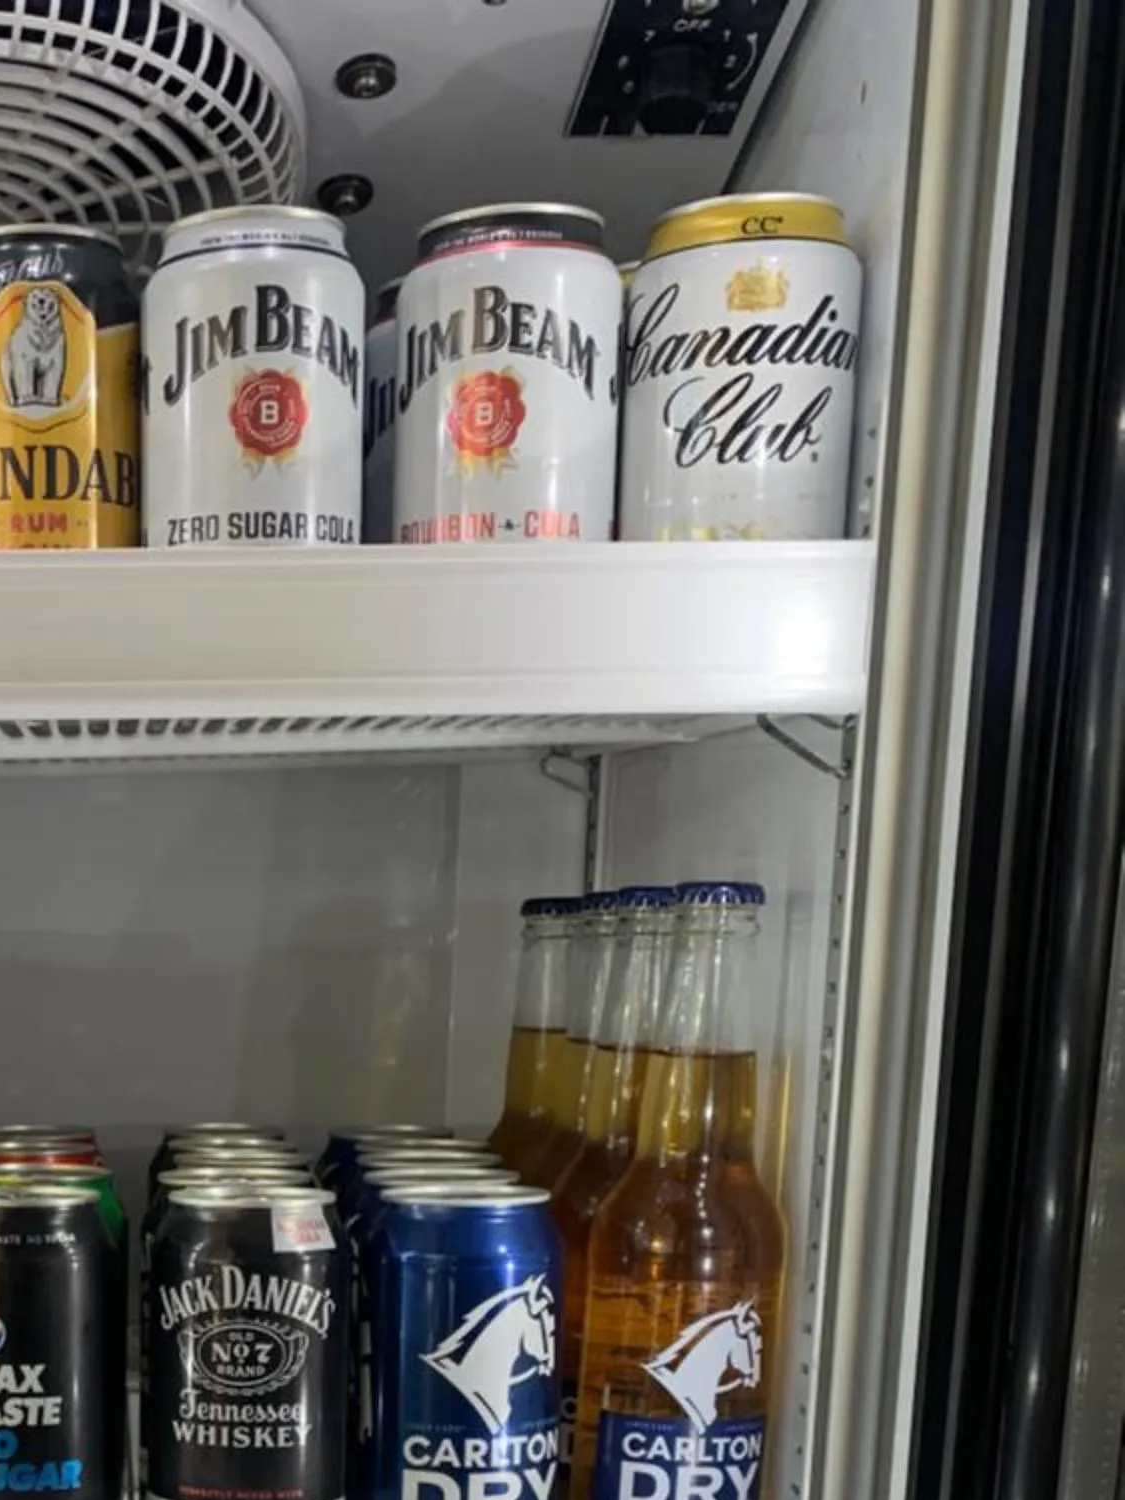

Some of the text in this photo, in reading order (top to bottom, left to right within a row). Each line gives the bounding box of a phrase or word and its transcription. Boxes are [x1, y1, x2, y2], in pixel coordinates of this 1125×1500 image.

[673, 19, 712, 32] OFF
[164, 284, 359, 409] JIM BEAM
[399, 284, 596, 413] JIM BEAM
[260, 401, 279, 424] B
[10, 512, 69, 533] RUM
[167, 512, 355, 546] ZERO SUGAR COLA
[401, 511, 496, 544] BOURBON
[523, 511, 580, 539] COLA
[159, 1265, 336, 1340] JACK DANIEL'S
[255, 1343, 274, 1363] 7
[217, 1365, 266, 1378] BRAND
[179, 1389, 306, 1423] Tennessee
[172, 1420, 312, 1448] WHISKEY
[403, 1428, 559, 1469] CARLTON
[622, 1432, 762, 1463] CARLTON
